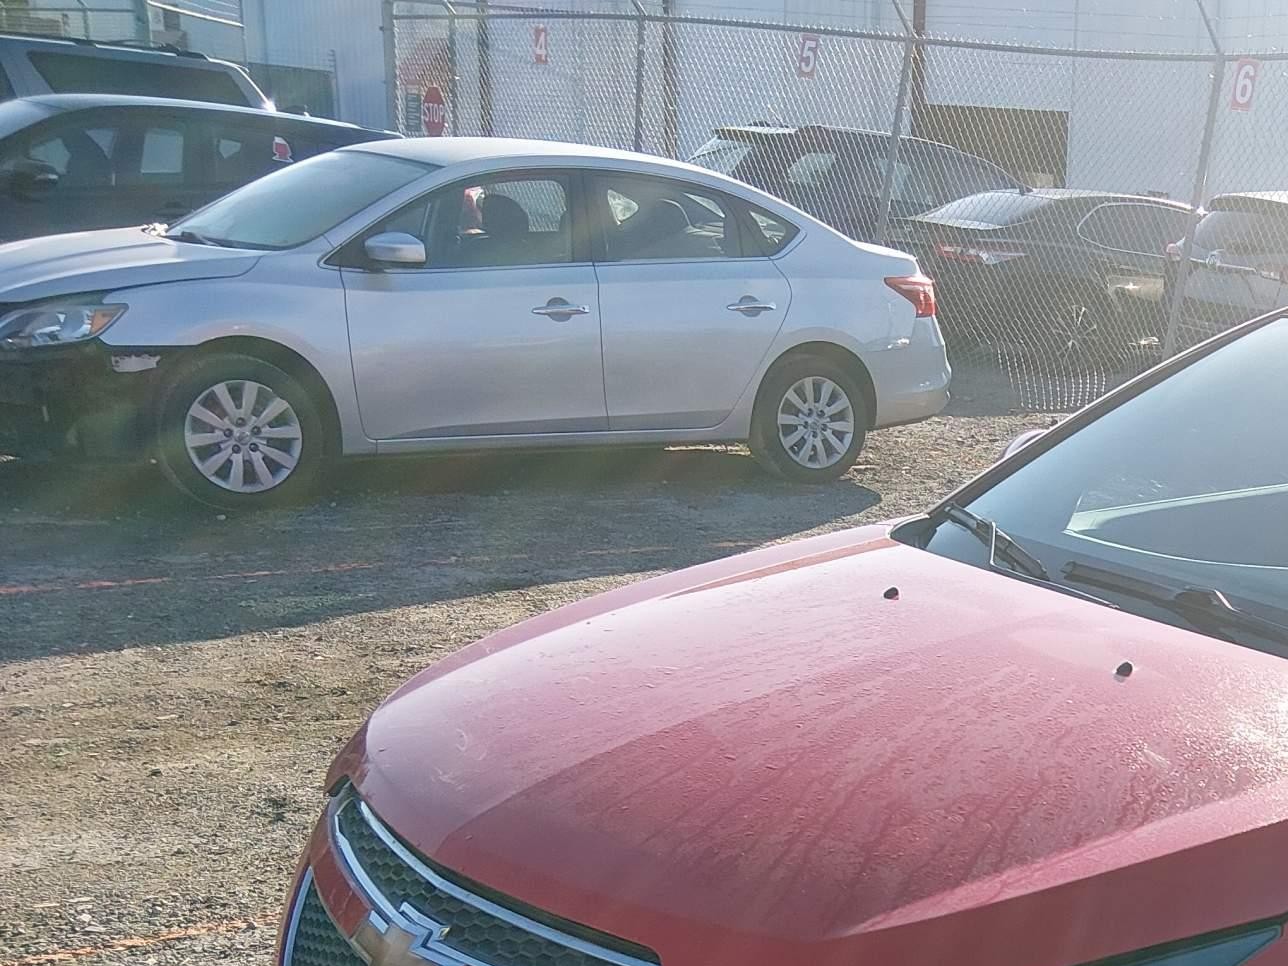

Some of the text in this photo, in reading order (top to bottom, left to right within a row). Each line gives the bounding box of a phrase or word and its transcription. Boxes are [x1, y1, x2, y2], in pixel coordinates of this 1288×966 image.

[535, 31, 547, 61] 4
[801, 41, 816, 72] 5
[1236, 64, 1255, 104] 6
[423, 102, 444, 123] STOP
